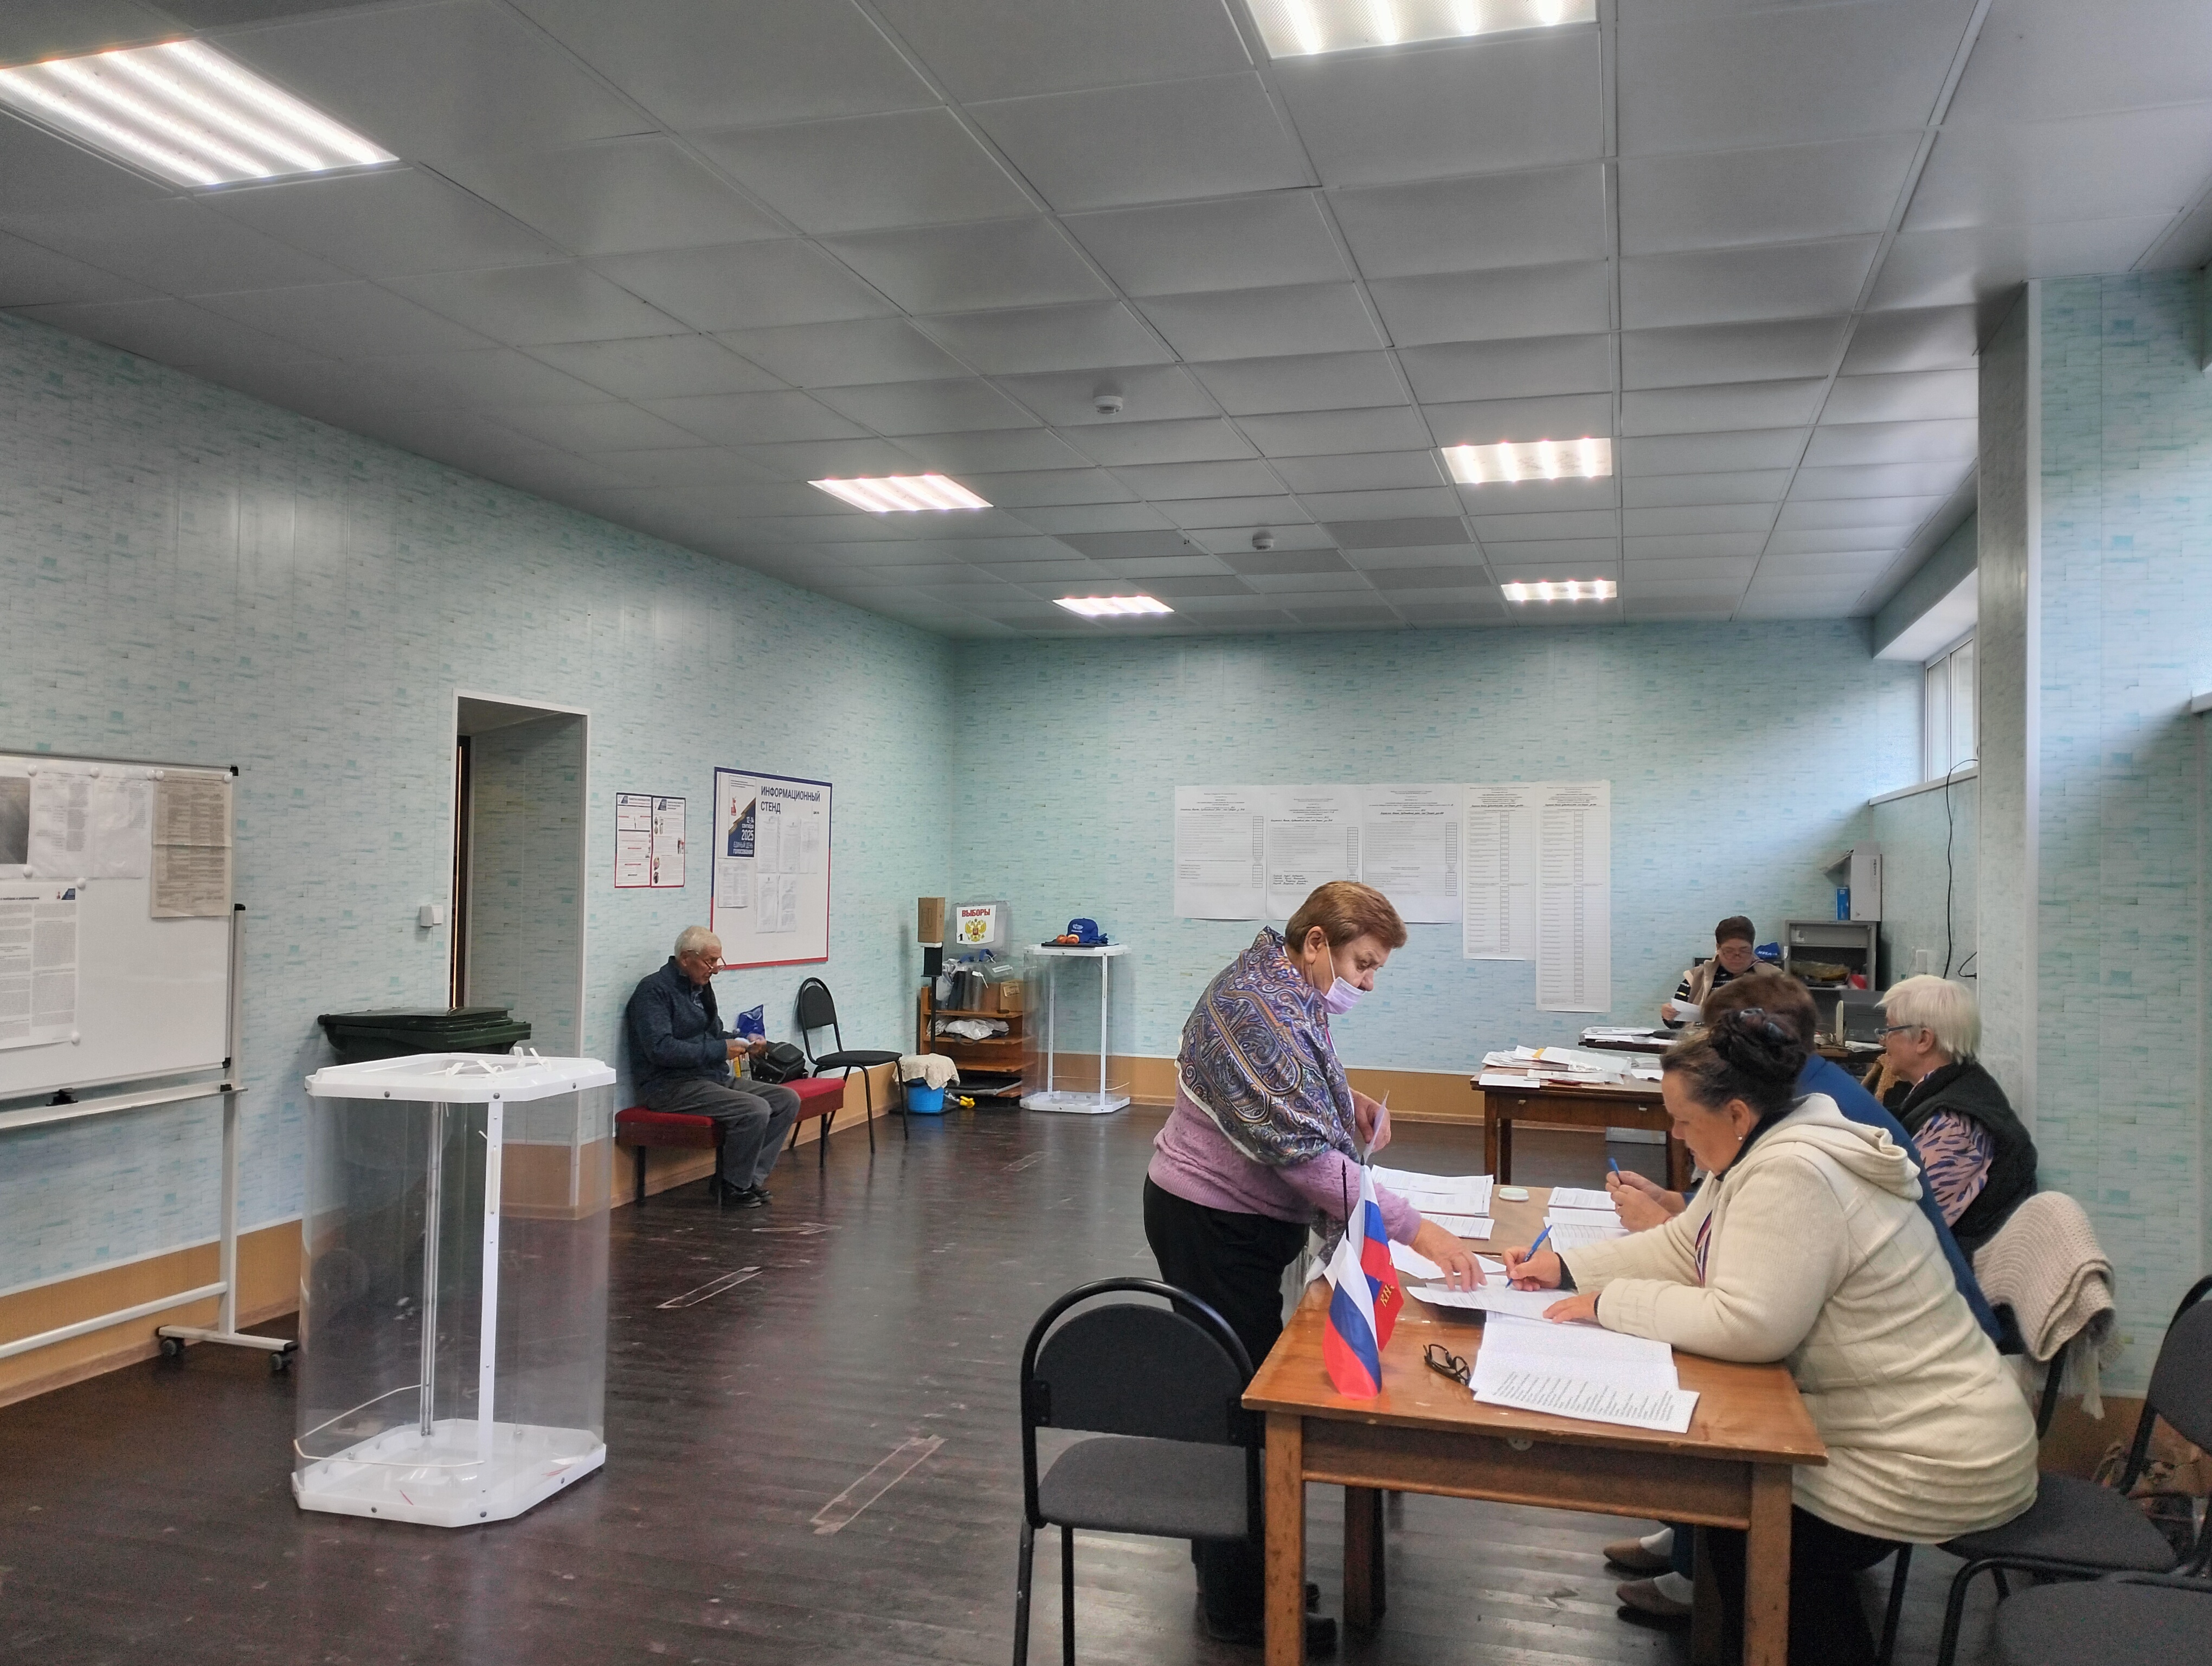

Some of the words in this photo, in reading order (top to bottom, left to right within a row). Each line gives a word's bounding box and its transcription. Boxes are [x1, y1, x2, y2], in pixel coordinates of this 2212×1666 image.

[761, 785, 820, 802] ИНФОРМАЦИОННЫЙ
[761, 801, 781, 815] СТЕНД
[741, 829, 754, 841] 2025
[962, 908, 991, 917] ВЫБОРЫ
